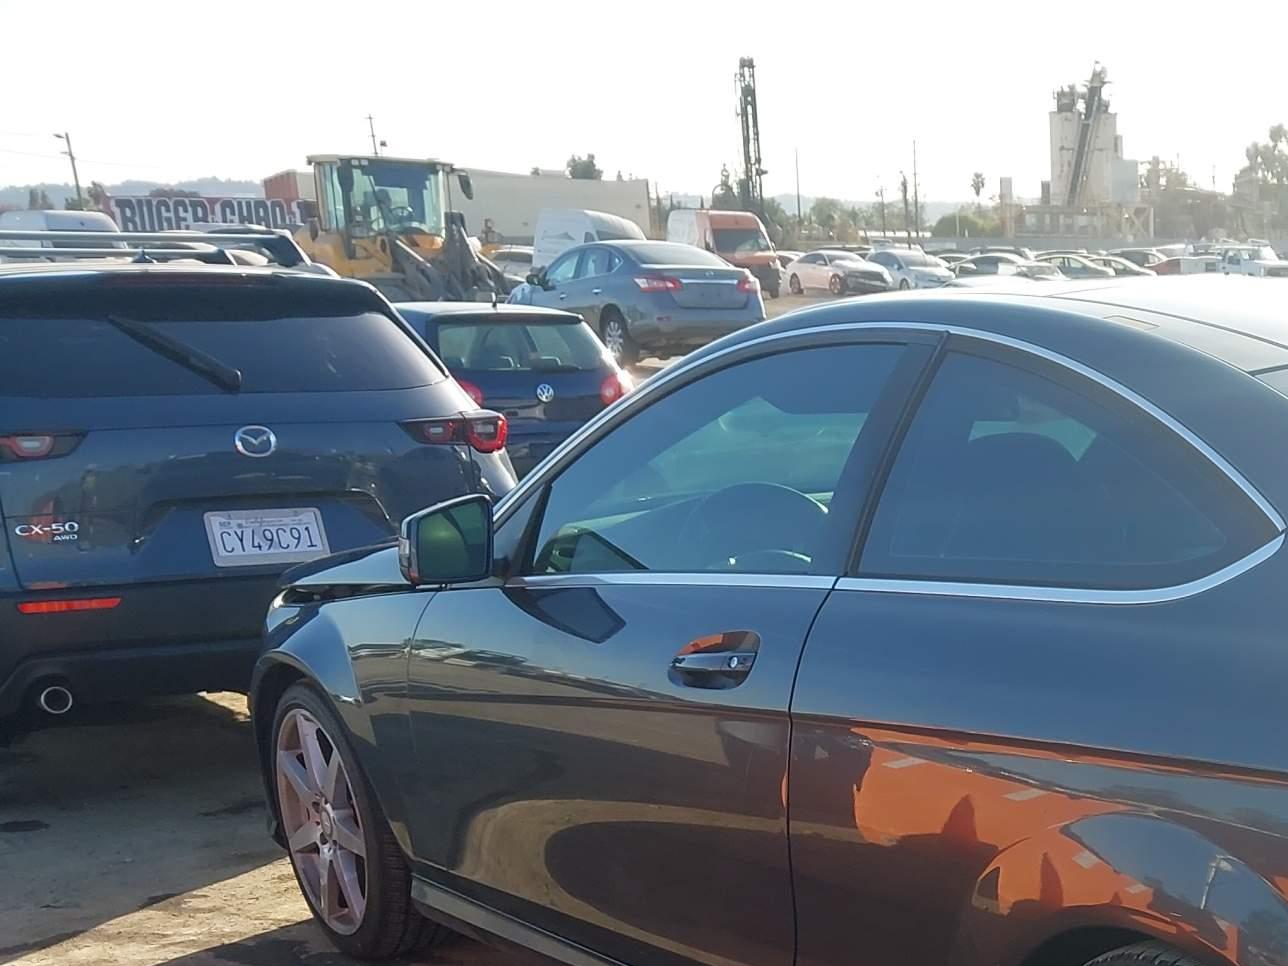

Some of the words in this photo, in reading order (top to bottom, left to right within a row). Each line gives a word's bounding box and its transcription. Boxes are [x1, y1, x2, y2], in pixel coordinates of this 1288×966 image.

[14, 521, 79, 536] CX-50
[53, 533, 78, 541] AWD
[220, 526, 317, 553] CY49C91
